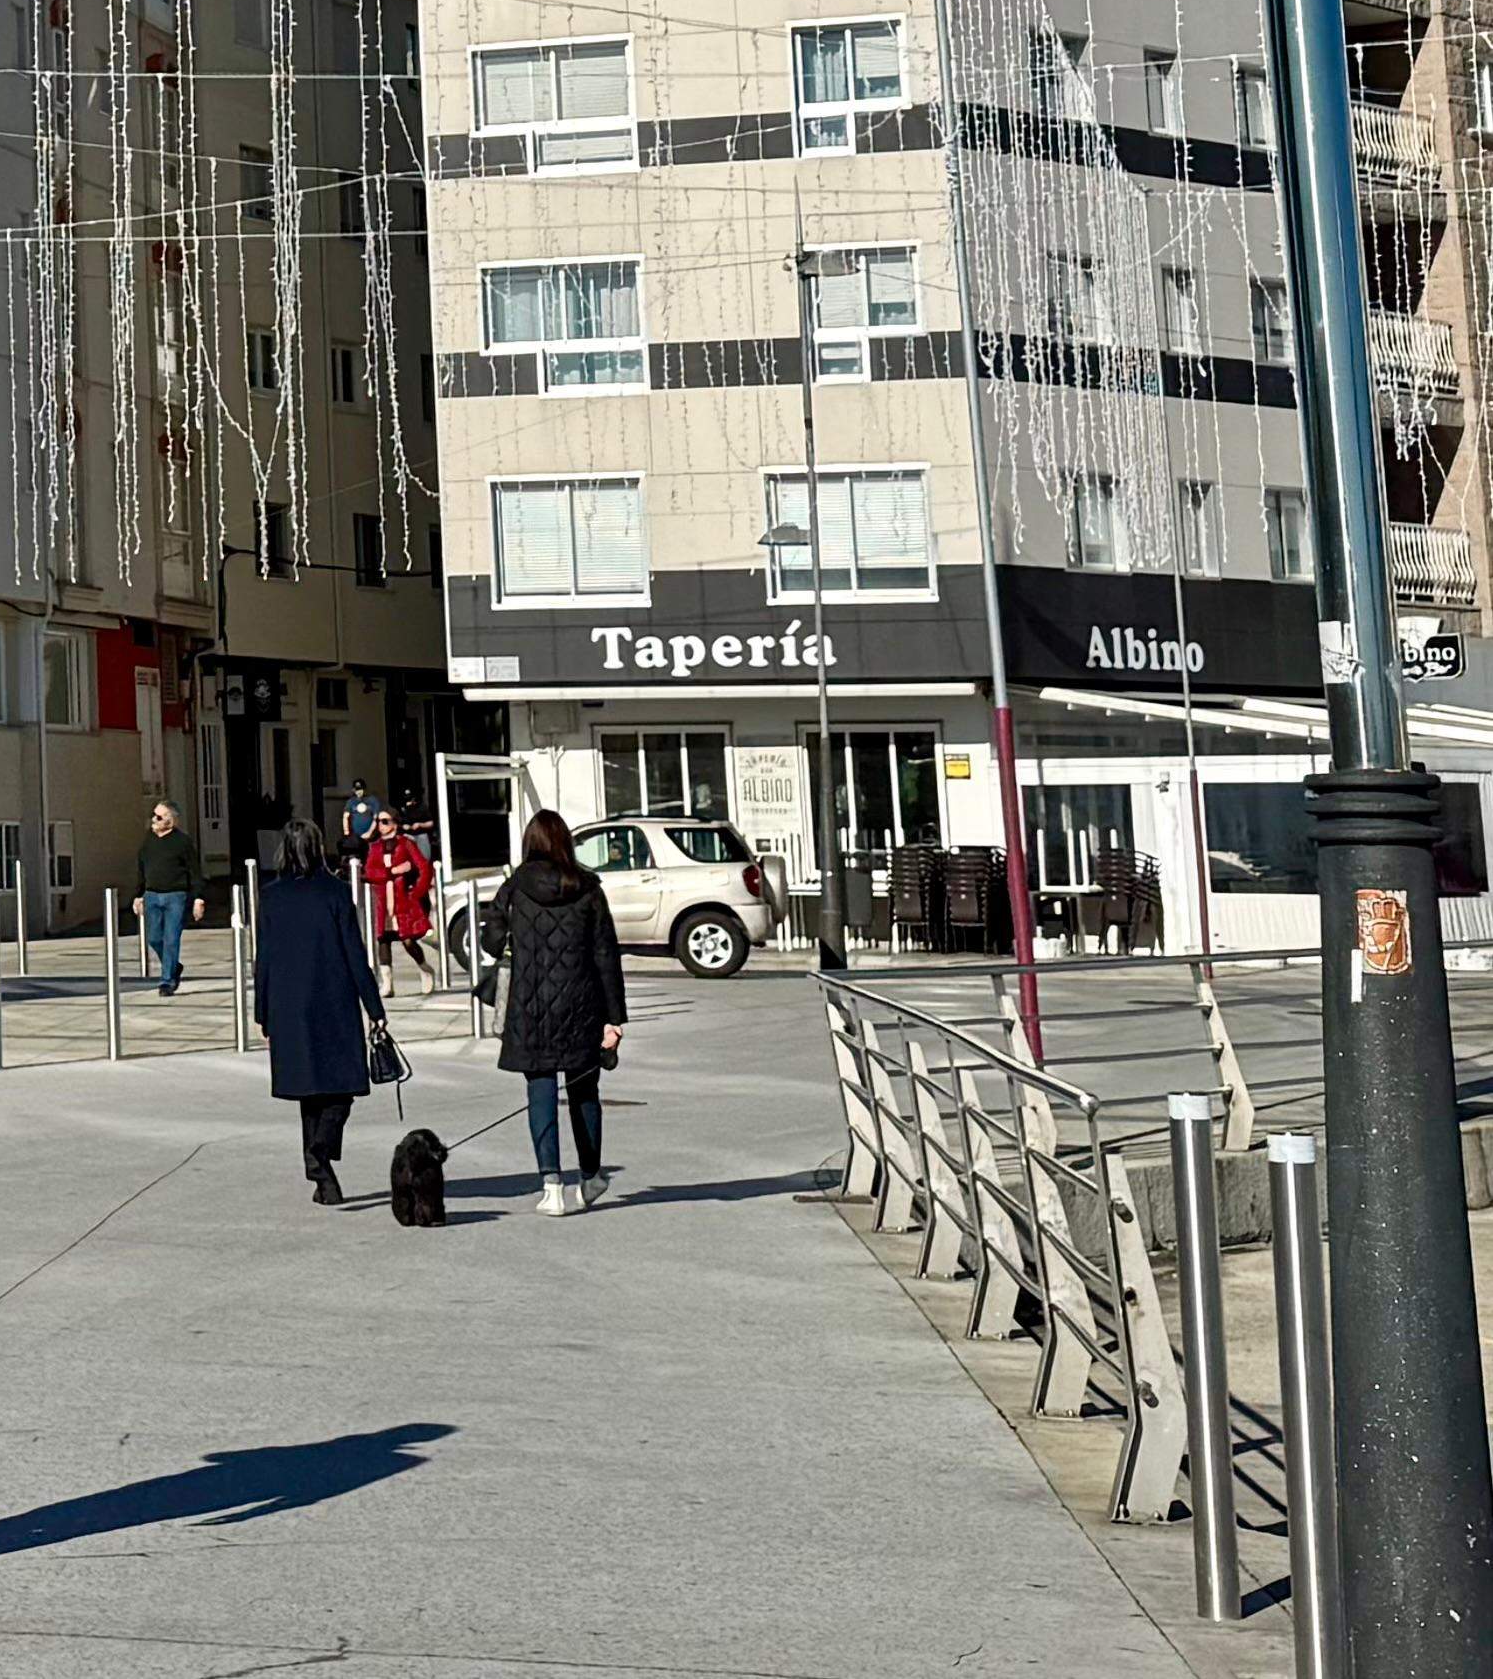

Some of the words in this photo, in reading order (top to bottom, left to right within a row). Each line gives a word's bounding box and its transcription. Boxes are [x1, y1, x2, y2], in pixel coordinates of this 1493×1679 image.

[591, 619, 837, 677] Tapería
[1085, 625, 1204, 673] Albino
[1402, 641, 1456, 663] bino
[743, 777, 793, 803] ALBINO
